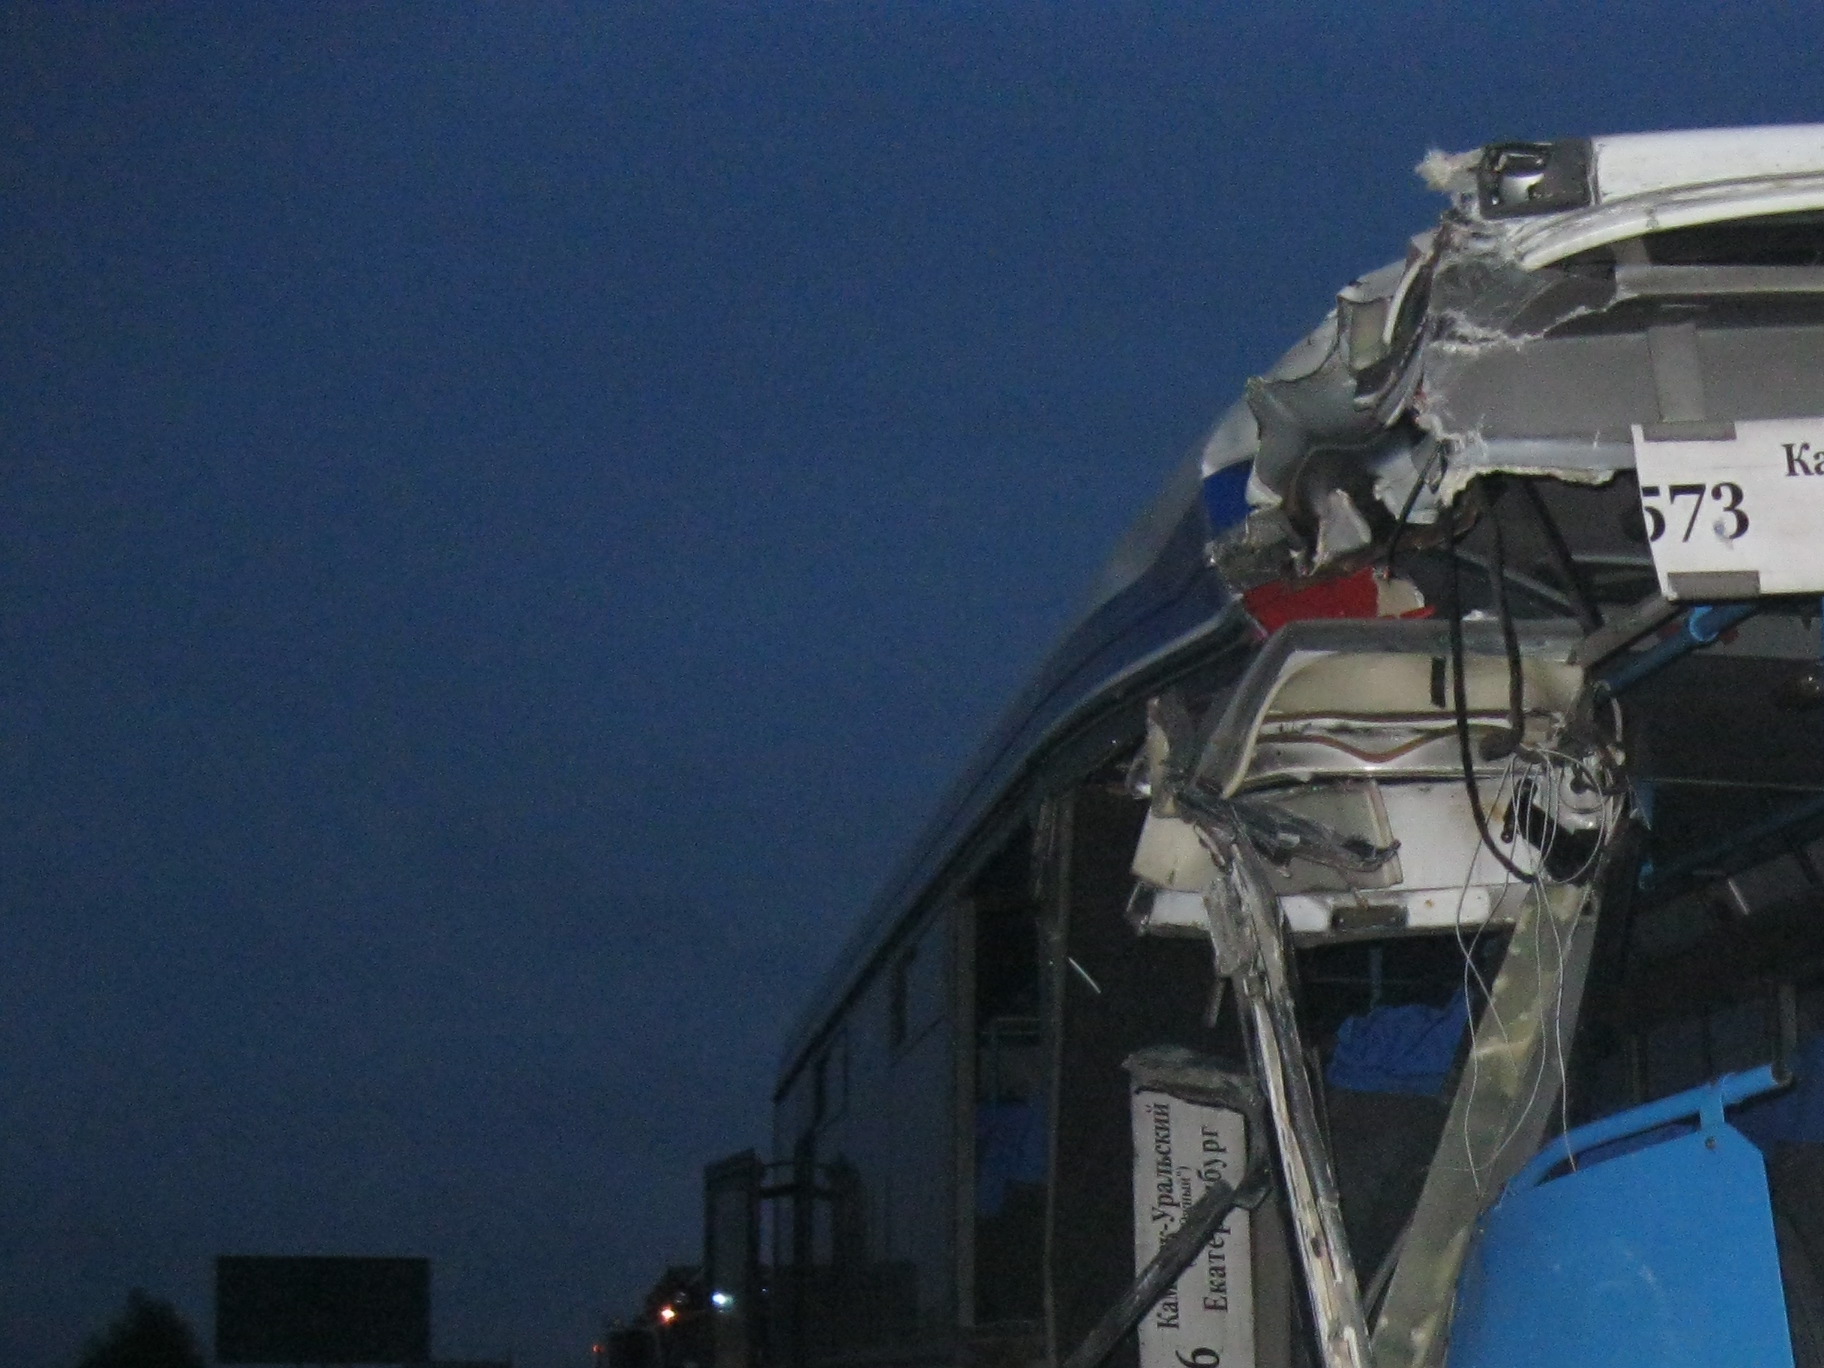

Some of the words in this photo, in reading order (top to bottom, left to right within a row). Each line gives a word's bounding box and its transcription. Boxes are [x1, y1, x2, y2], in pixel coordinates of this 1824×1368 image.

[1641, 482, 1750, 543] 573
[1145, 1102, 1180, 1331] Ка-Уральский
[1197, 1126, 1232, 1314] Екатебург
